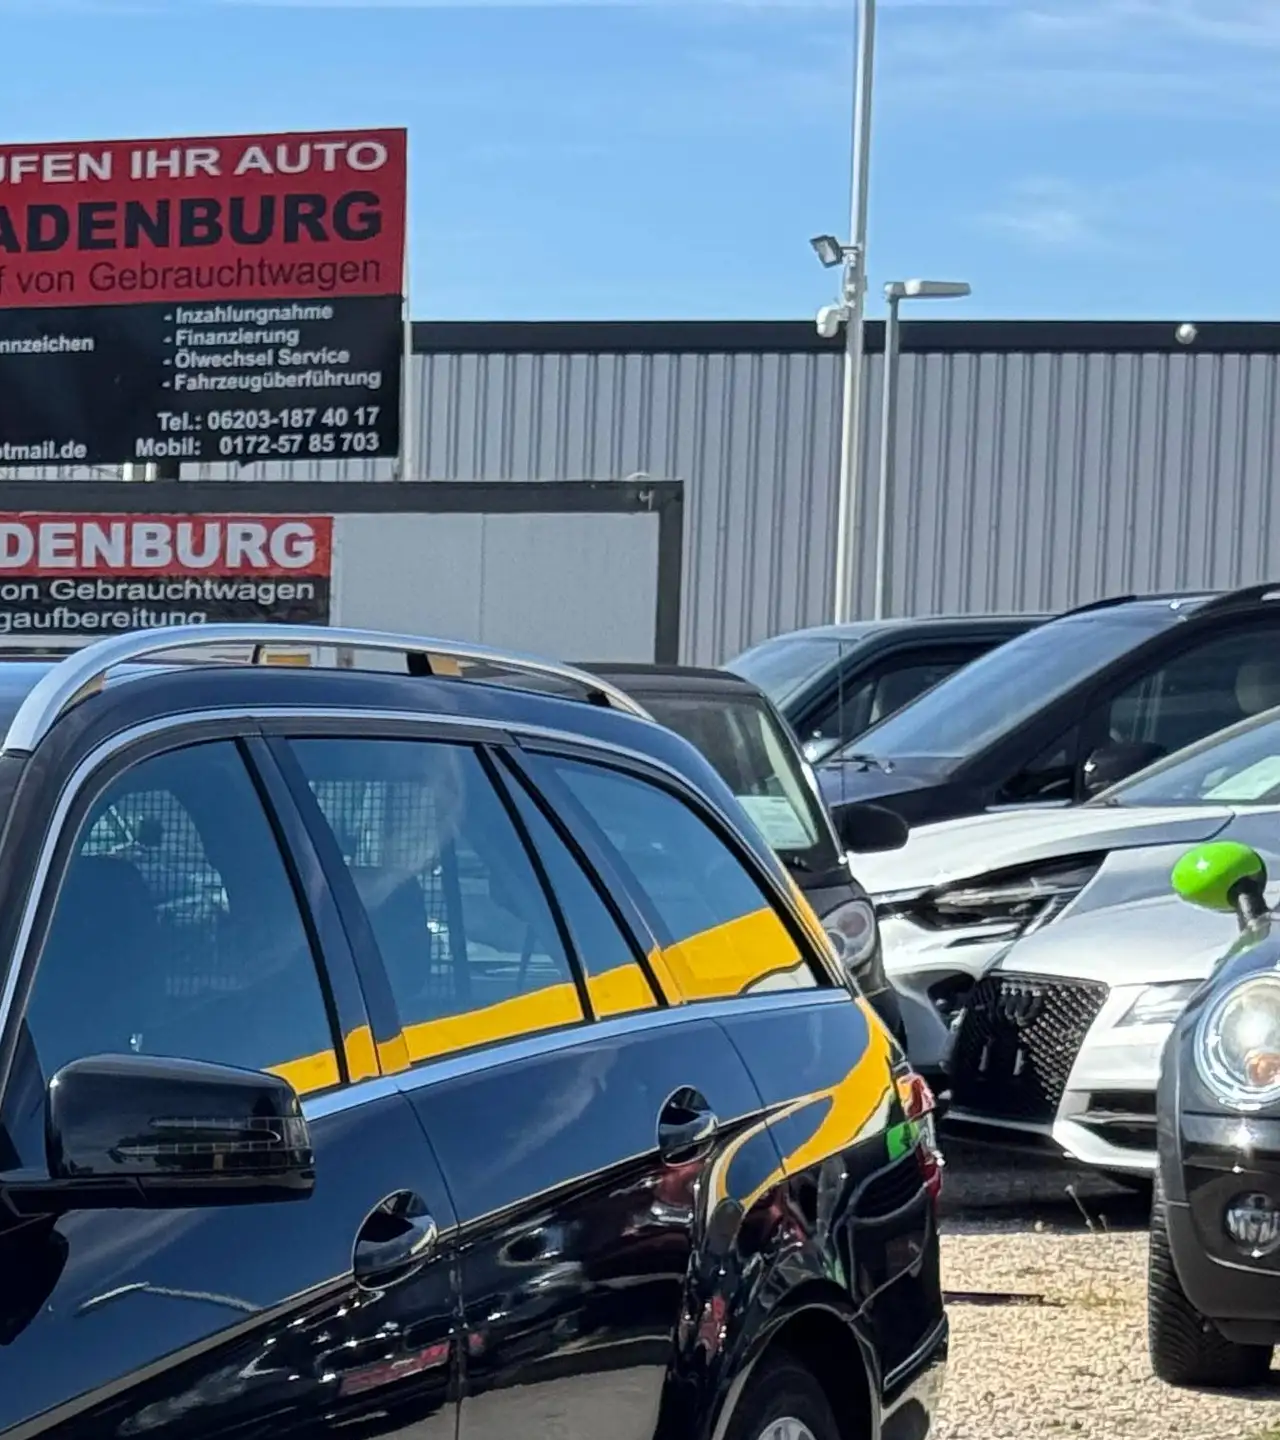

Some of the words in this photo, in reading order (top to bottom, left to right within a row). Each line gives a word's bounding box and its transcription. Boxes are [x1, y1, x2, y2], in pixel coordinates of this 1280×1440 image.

[130, 147, 221, 180] IHR
[234, 141, 388, 176] AUTO
[16, 269, 74, 294] von
[90, 258, 380, 292] Gebrauchtwagen
[176, 304, 333, 325] Inzahlungnahme
[176, 329, 300, 346] Finanzierung
[175, 349, 273, 368] Ölwechsel
[278, 348, 350, 366] Service
[175, 370, 382, 393] Fahrzeugüberführung
[157, 411, 202, 431] Tel.:
[207, 408, 316, 430] 06203-187
[321, 407, 349, 427] 40
[355, 406, 380, 426] 17
[136, 436, 201, 457] Mobil:
[219, 434, 303, 454] 0172-57
[308, 432, 336, 452] 85
[342, 432, 379, 451] 703
[49, 579, 314, 605] Gebrauchtwagen
